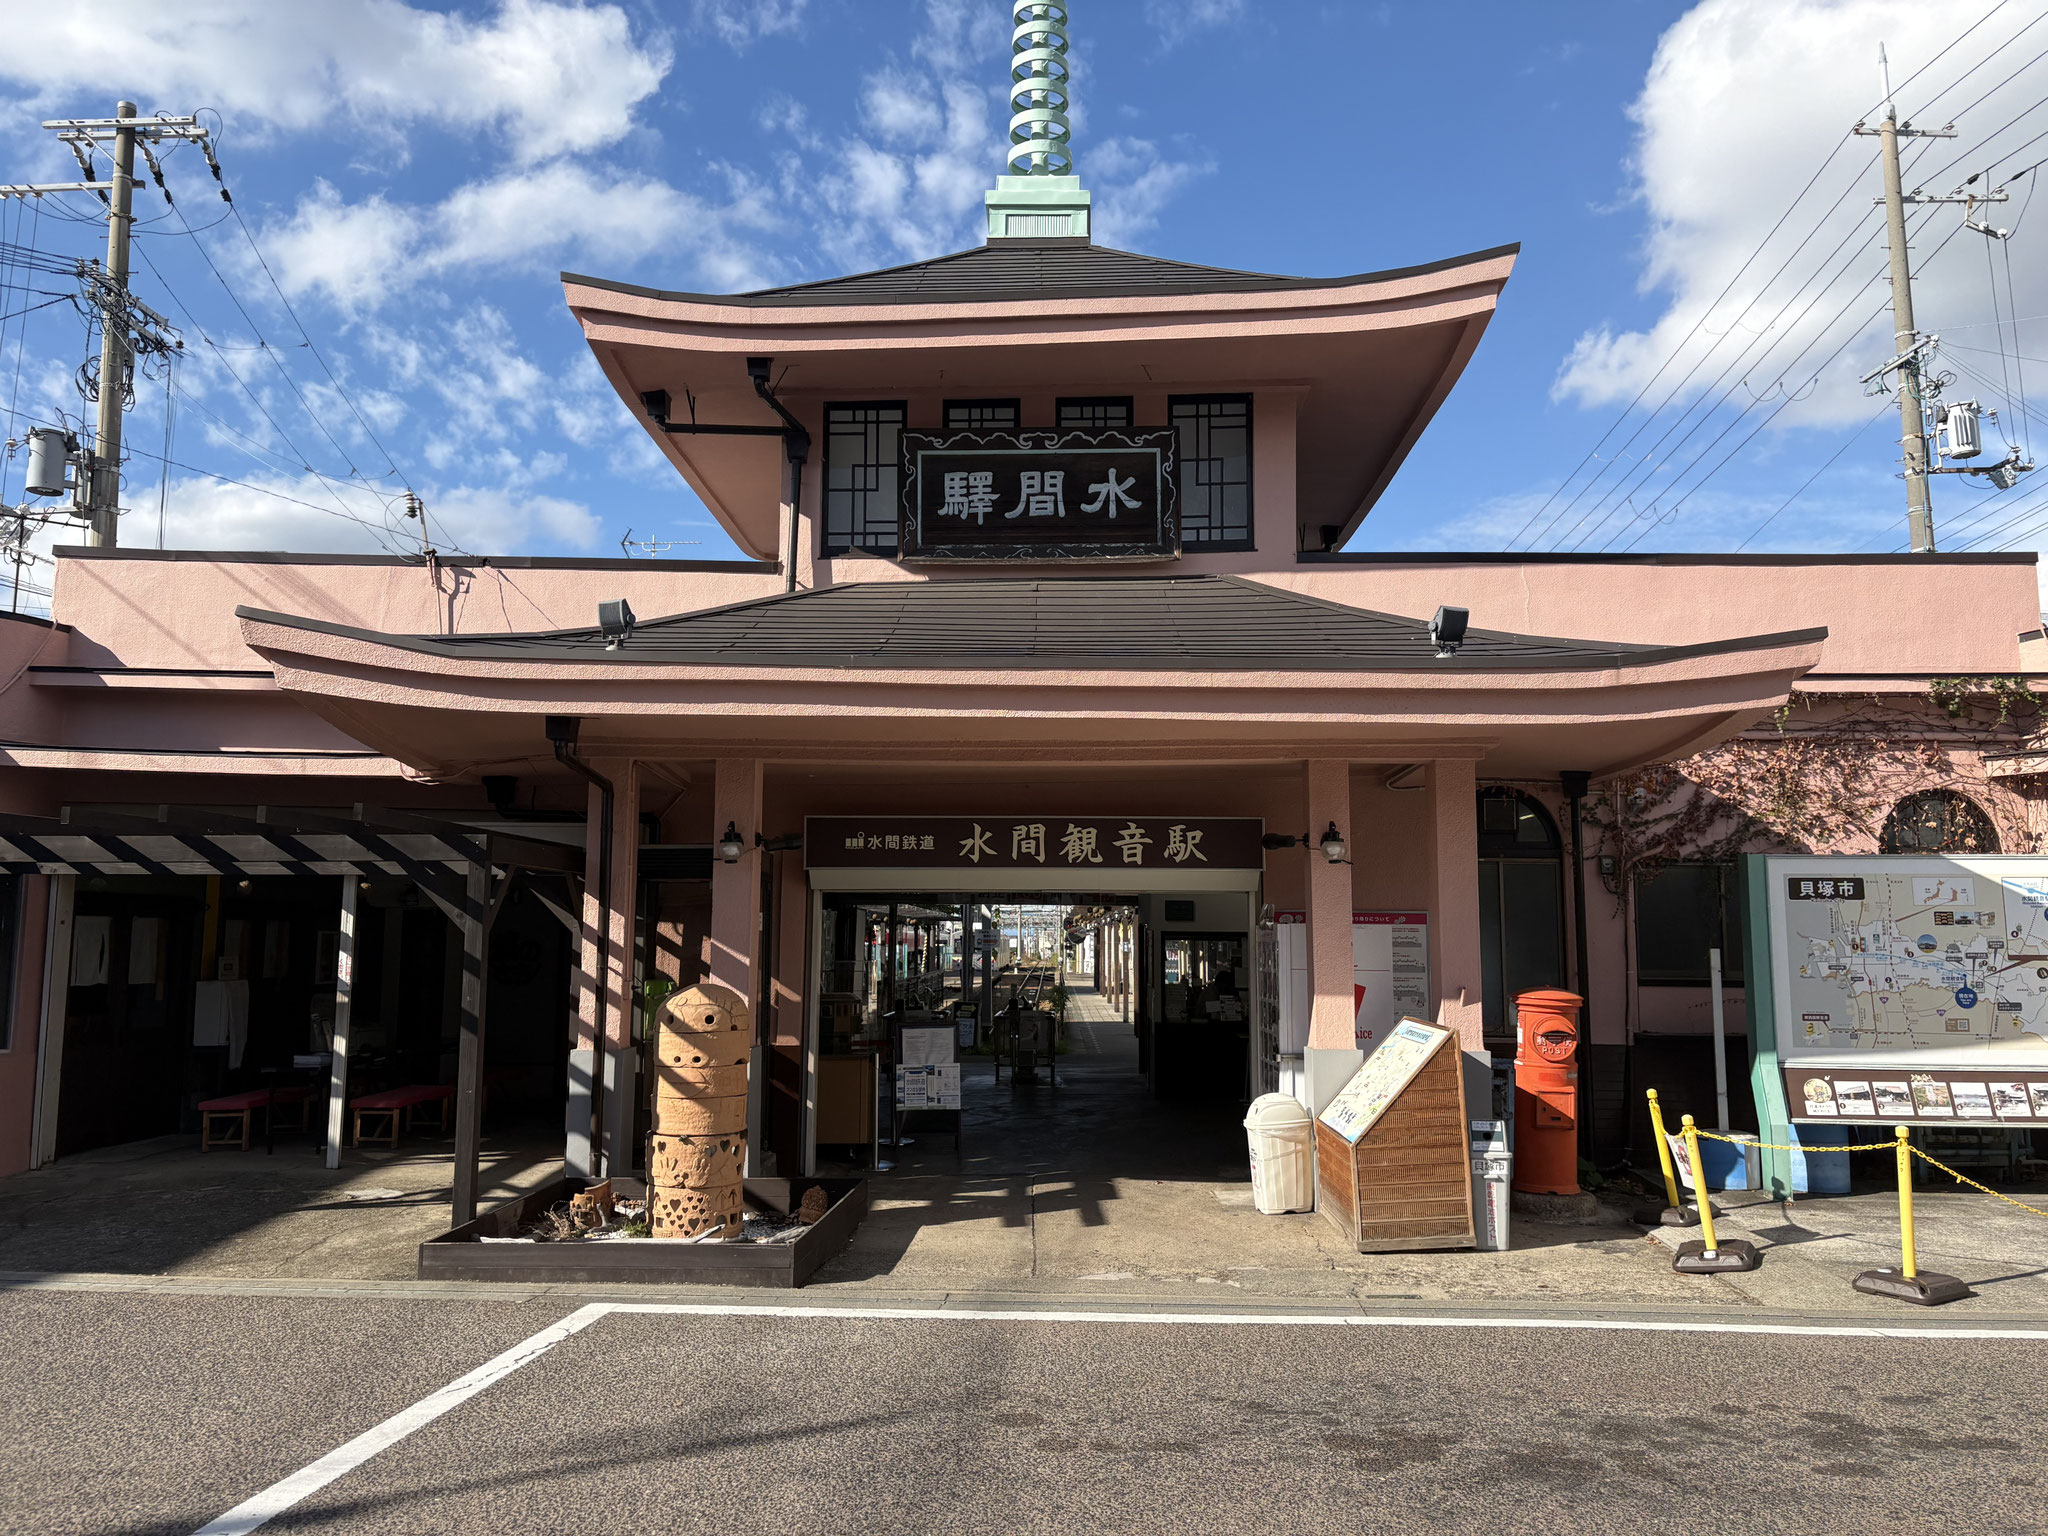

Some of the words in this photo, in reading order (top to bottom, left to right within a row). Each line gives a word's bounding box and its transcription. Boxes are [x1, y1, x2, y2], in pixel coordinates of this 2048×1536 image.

[867, 834, 935, 850] 水間鉄道
[958, 822, 1209, 865] 水間観音駅
[1799, 880, 1855, 897] 貝塚市
[1352, 915, 1390, 923] り降りについて
[1542, 1047, 1568, 1055] POST
